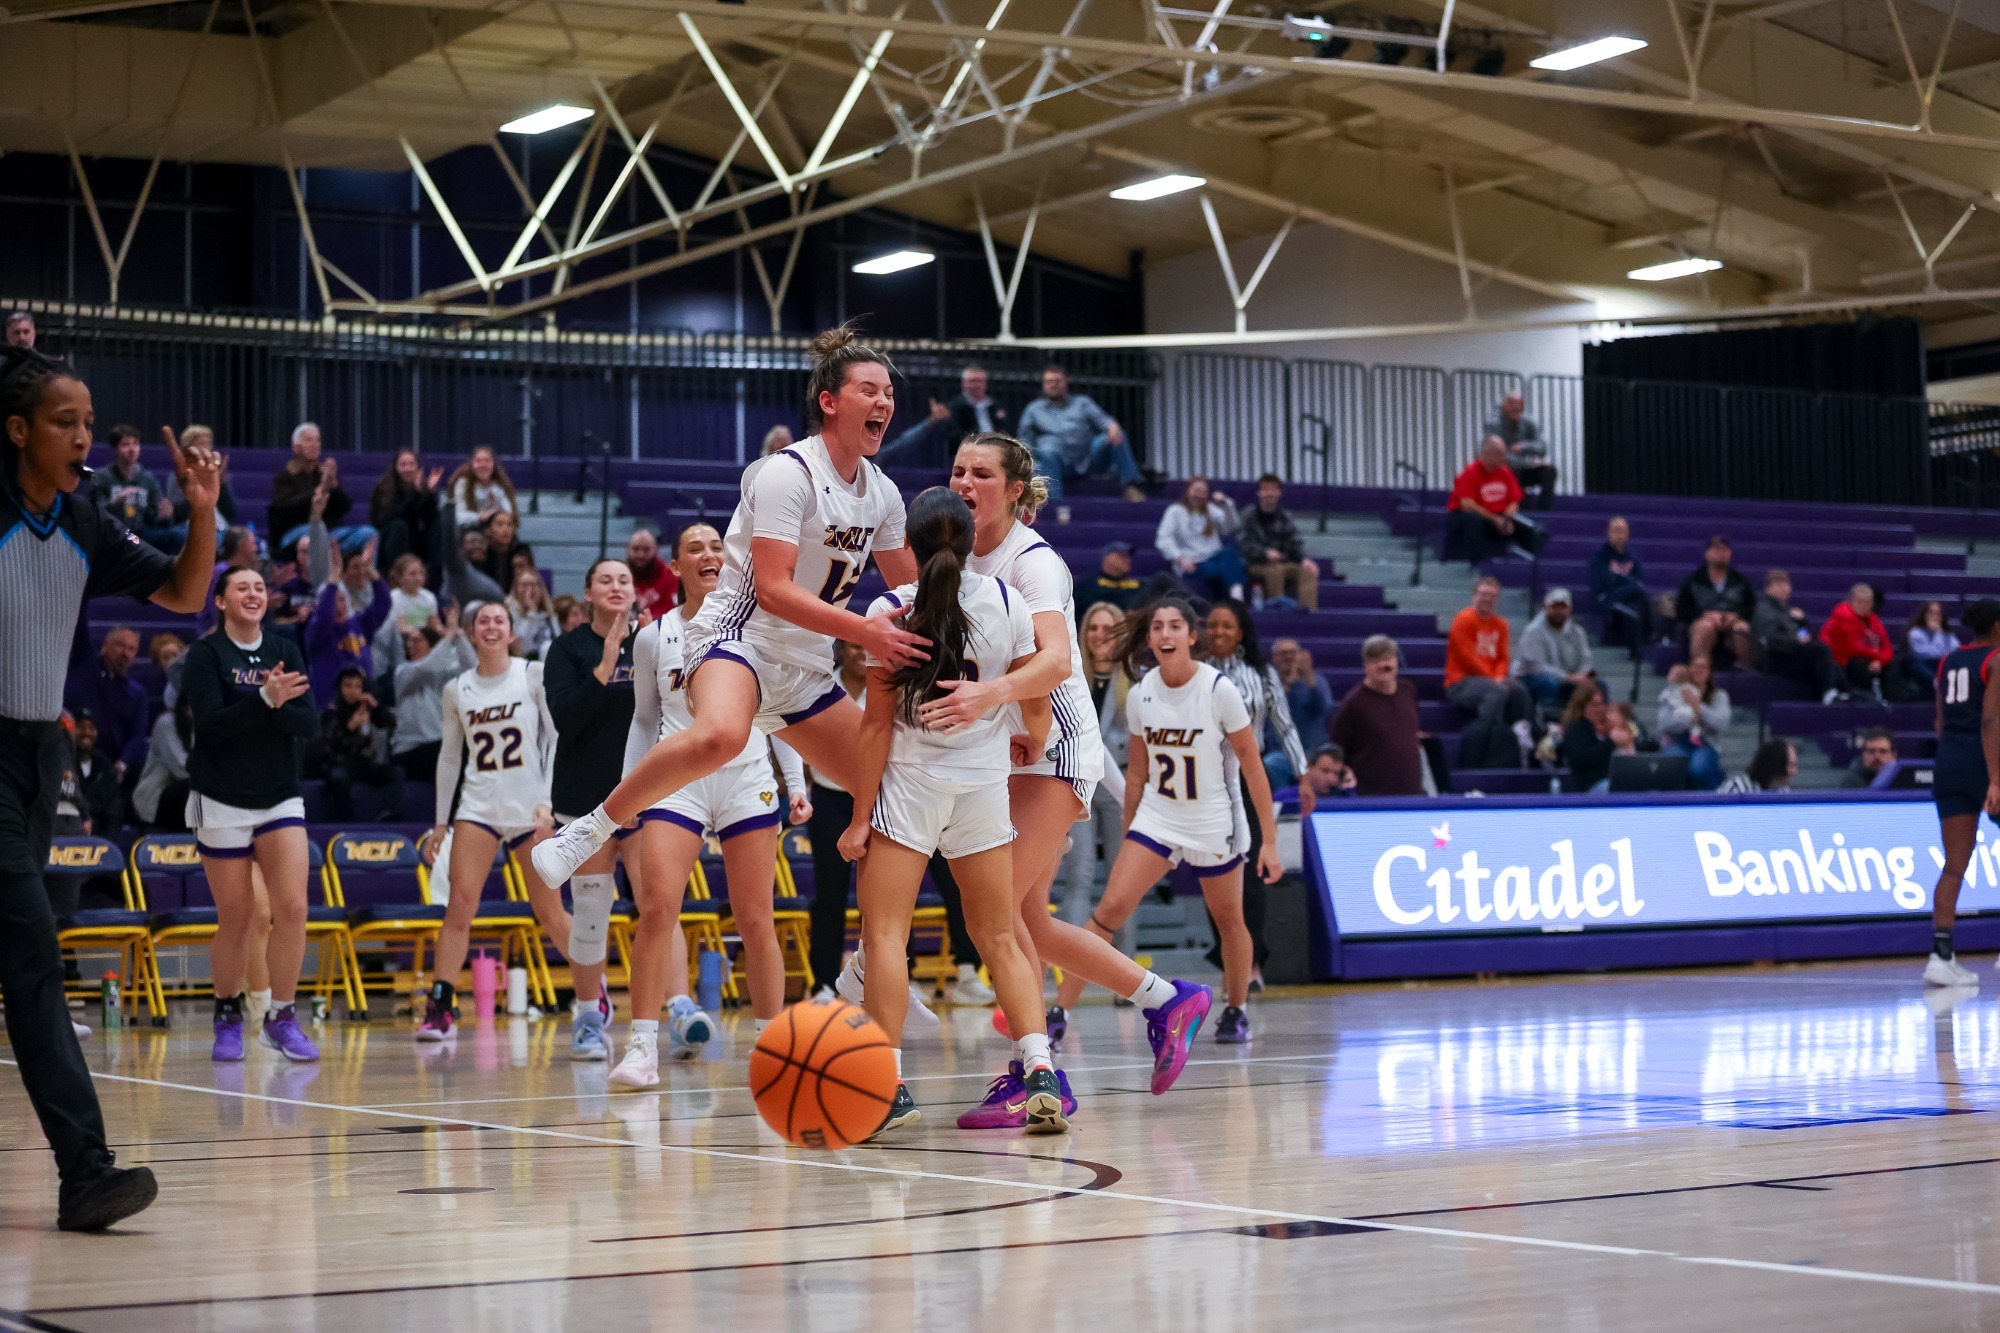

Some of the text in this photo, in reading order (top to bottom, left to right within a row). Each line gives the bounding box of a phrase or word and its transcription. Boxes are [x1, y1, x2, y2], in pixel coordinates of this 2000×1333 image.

[823, 525, 874, 553] WCU
[1945, 667, 1970, 704] 10
[465, 702, 521, 726] WCU
[472, 726, 523, 773] 22
[1144, 726, 1203, 747] WCU
[1156, 753, 1197, 800] 21
[49, 845, 109, 866] WCU
[343, 840, 404, 862] WCU
[1372, 837, 1645, 925] Citadel
[1693, 828, 1926, 910] Banking
